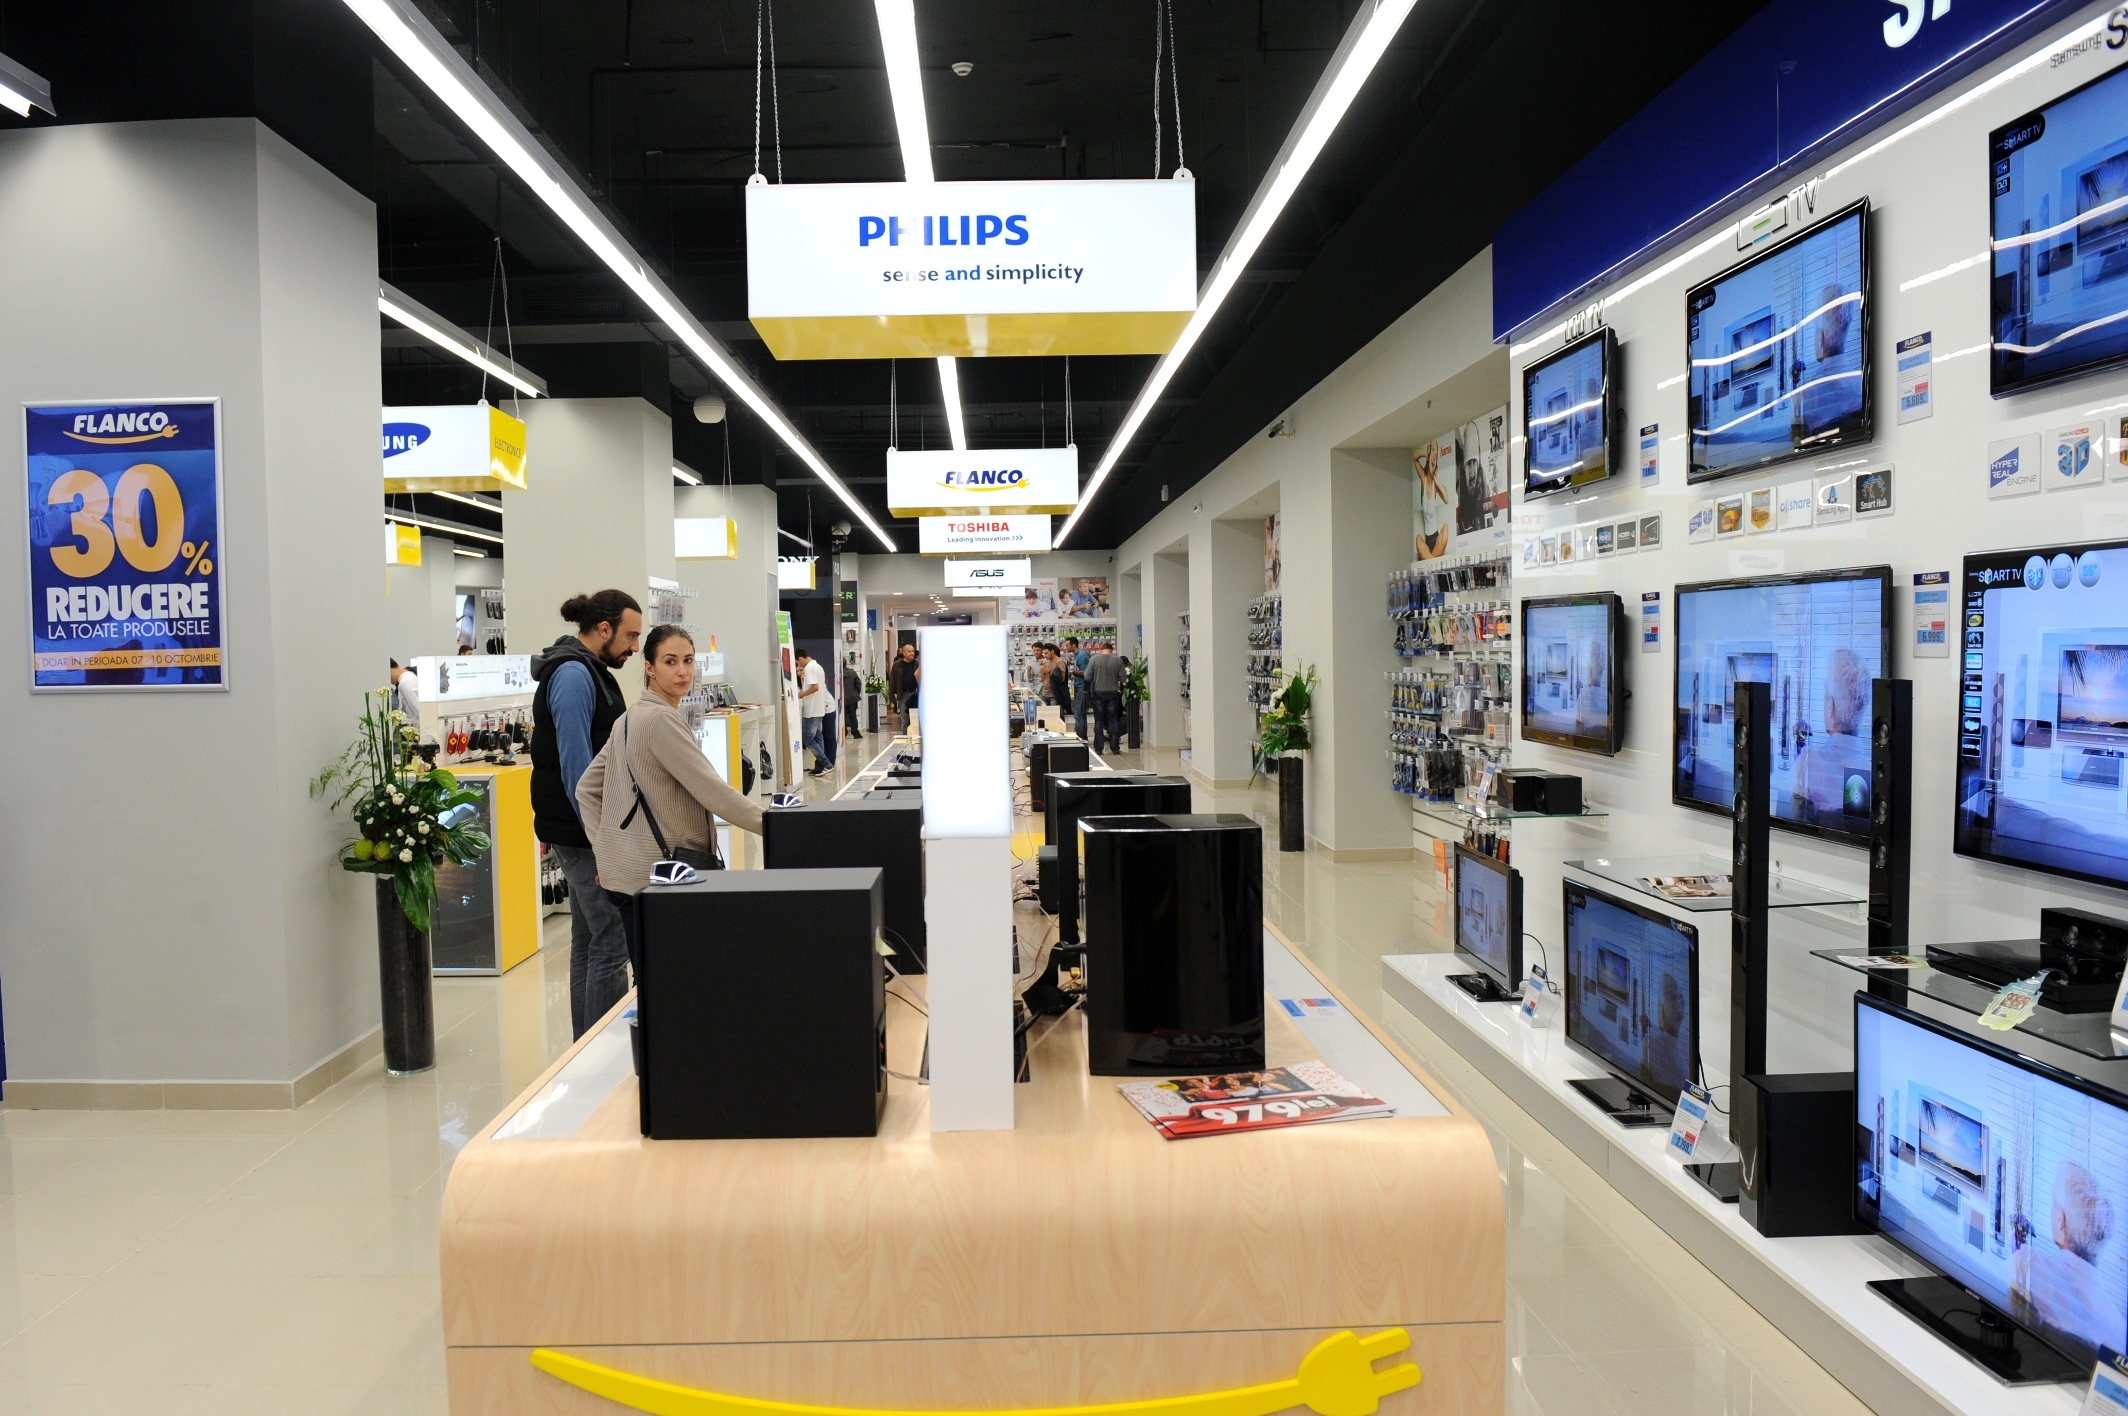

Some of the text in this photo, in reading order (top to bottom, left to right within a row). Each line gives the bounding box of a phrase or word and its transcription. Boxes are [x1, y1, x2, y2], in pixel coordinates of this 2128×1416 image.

[2051, 33, 2102, 68] Samsung
[2004, 127, 2031, 150] SMART
[858, 214, 1029, 247] PHILIPS
[882, 263, 1085, 285] sense and simplicity
[73, 411, 169, 434] FLANCO
[494, 436, 522, 460] ELECTRONICE
[1440, 445, 1452, 457] hama
[1991, 458, 2018, 470] HYPER
[945, 469, 1023, 485] FLANCO
[1991, 471, 2012, 479] REAL
[2006, 474, 2038, 486] ENGINE
[1860, 498, 1888, 510] Smart Hub
[47, 463, 213, 578] 30%
[947, 522, 1010, 533] TOSHIBA
[969, 569, 1005, 578] ASUS
[1978, 568, 2011, 585] SMART
[2012, 568, 2022, 580] TV
[46, 582, 210, 622] REDUCERE
[48, 620, 211, 640] LA TOATE PRODUSELE
[42, 657, 69, 667] DOAR
[84, 656, 129, 666] PERIOADA
[131, 655, 143, 665] 07
[151, 655, 163, 664] 10
[164, 653, 219, 664] OCTOMBRIE
[1201, 1095, 1337, 1126] 979 lei
